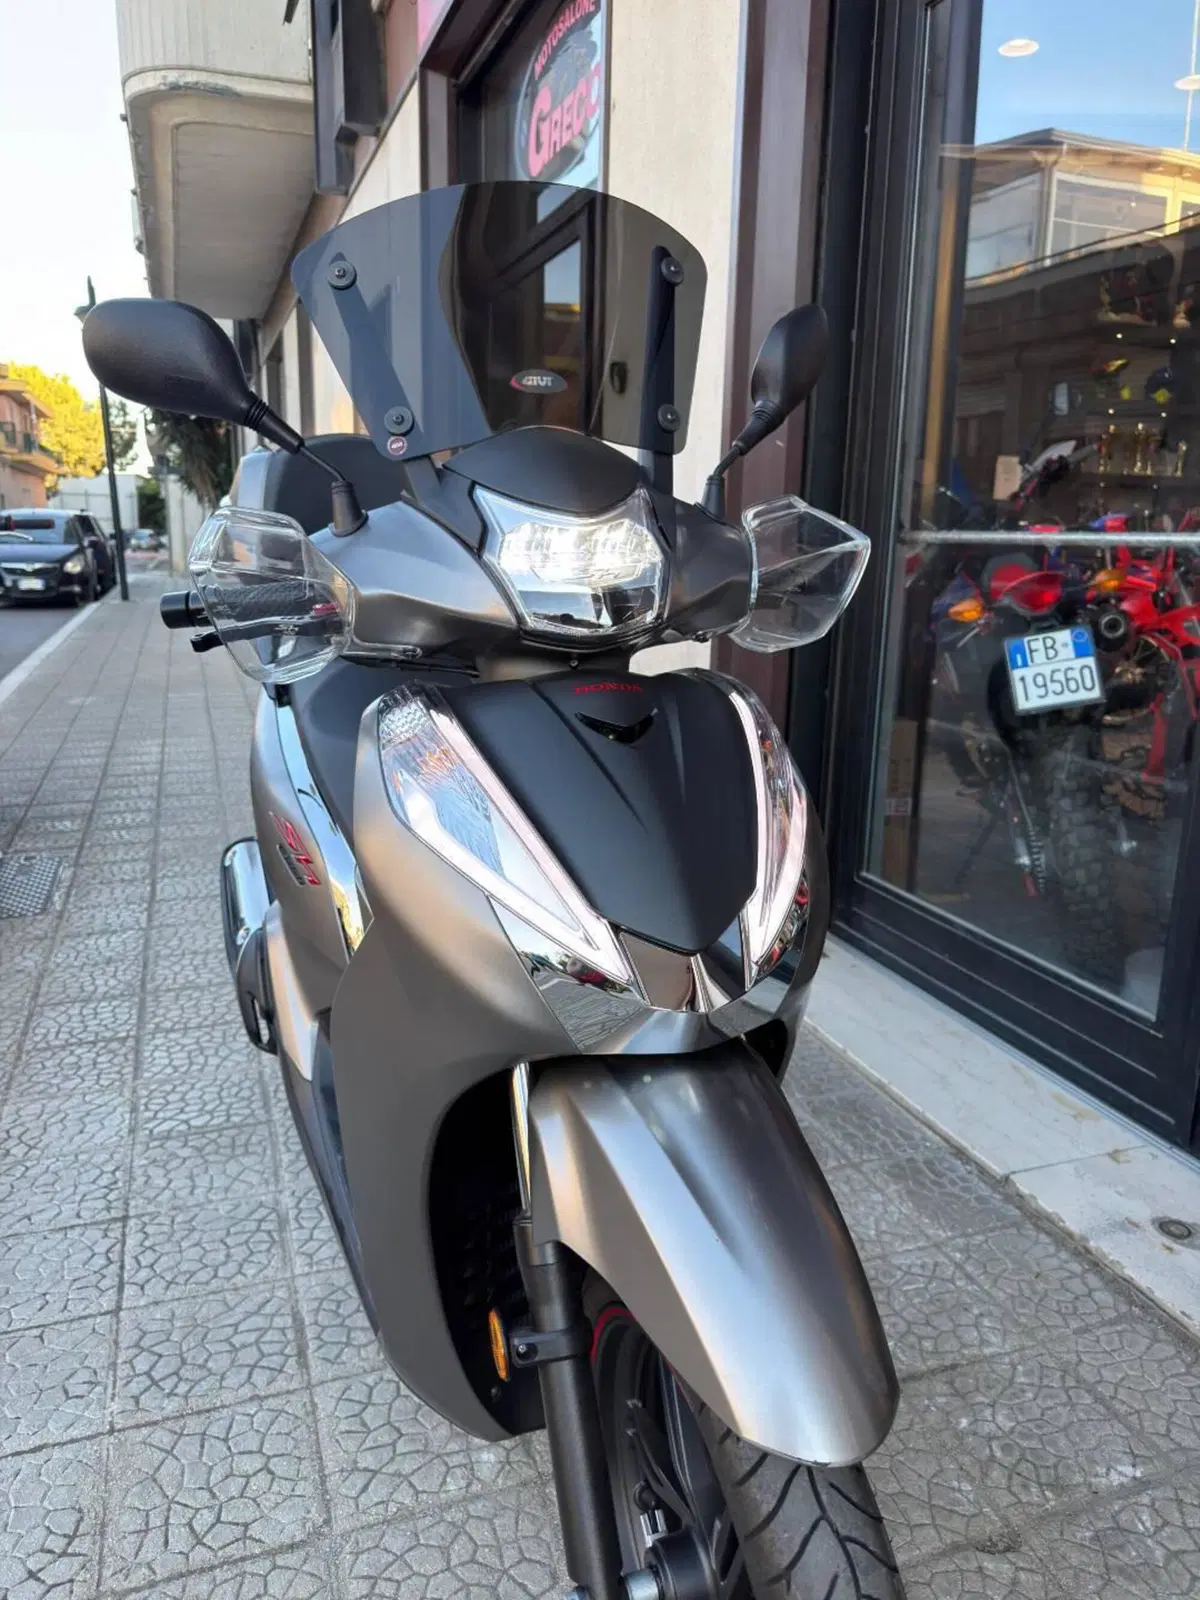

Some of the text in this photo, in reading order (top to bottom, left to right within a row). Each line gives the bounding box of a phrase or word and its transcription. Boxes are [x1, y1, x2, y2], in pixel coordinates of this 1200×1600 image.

[534, 0, 596, 80] MOTOSALONE
[1027, 635, 1059, 663] FB
[573, 682, 644, 695] HONDA
[1018, 664, 1096, 702] 19560
